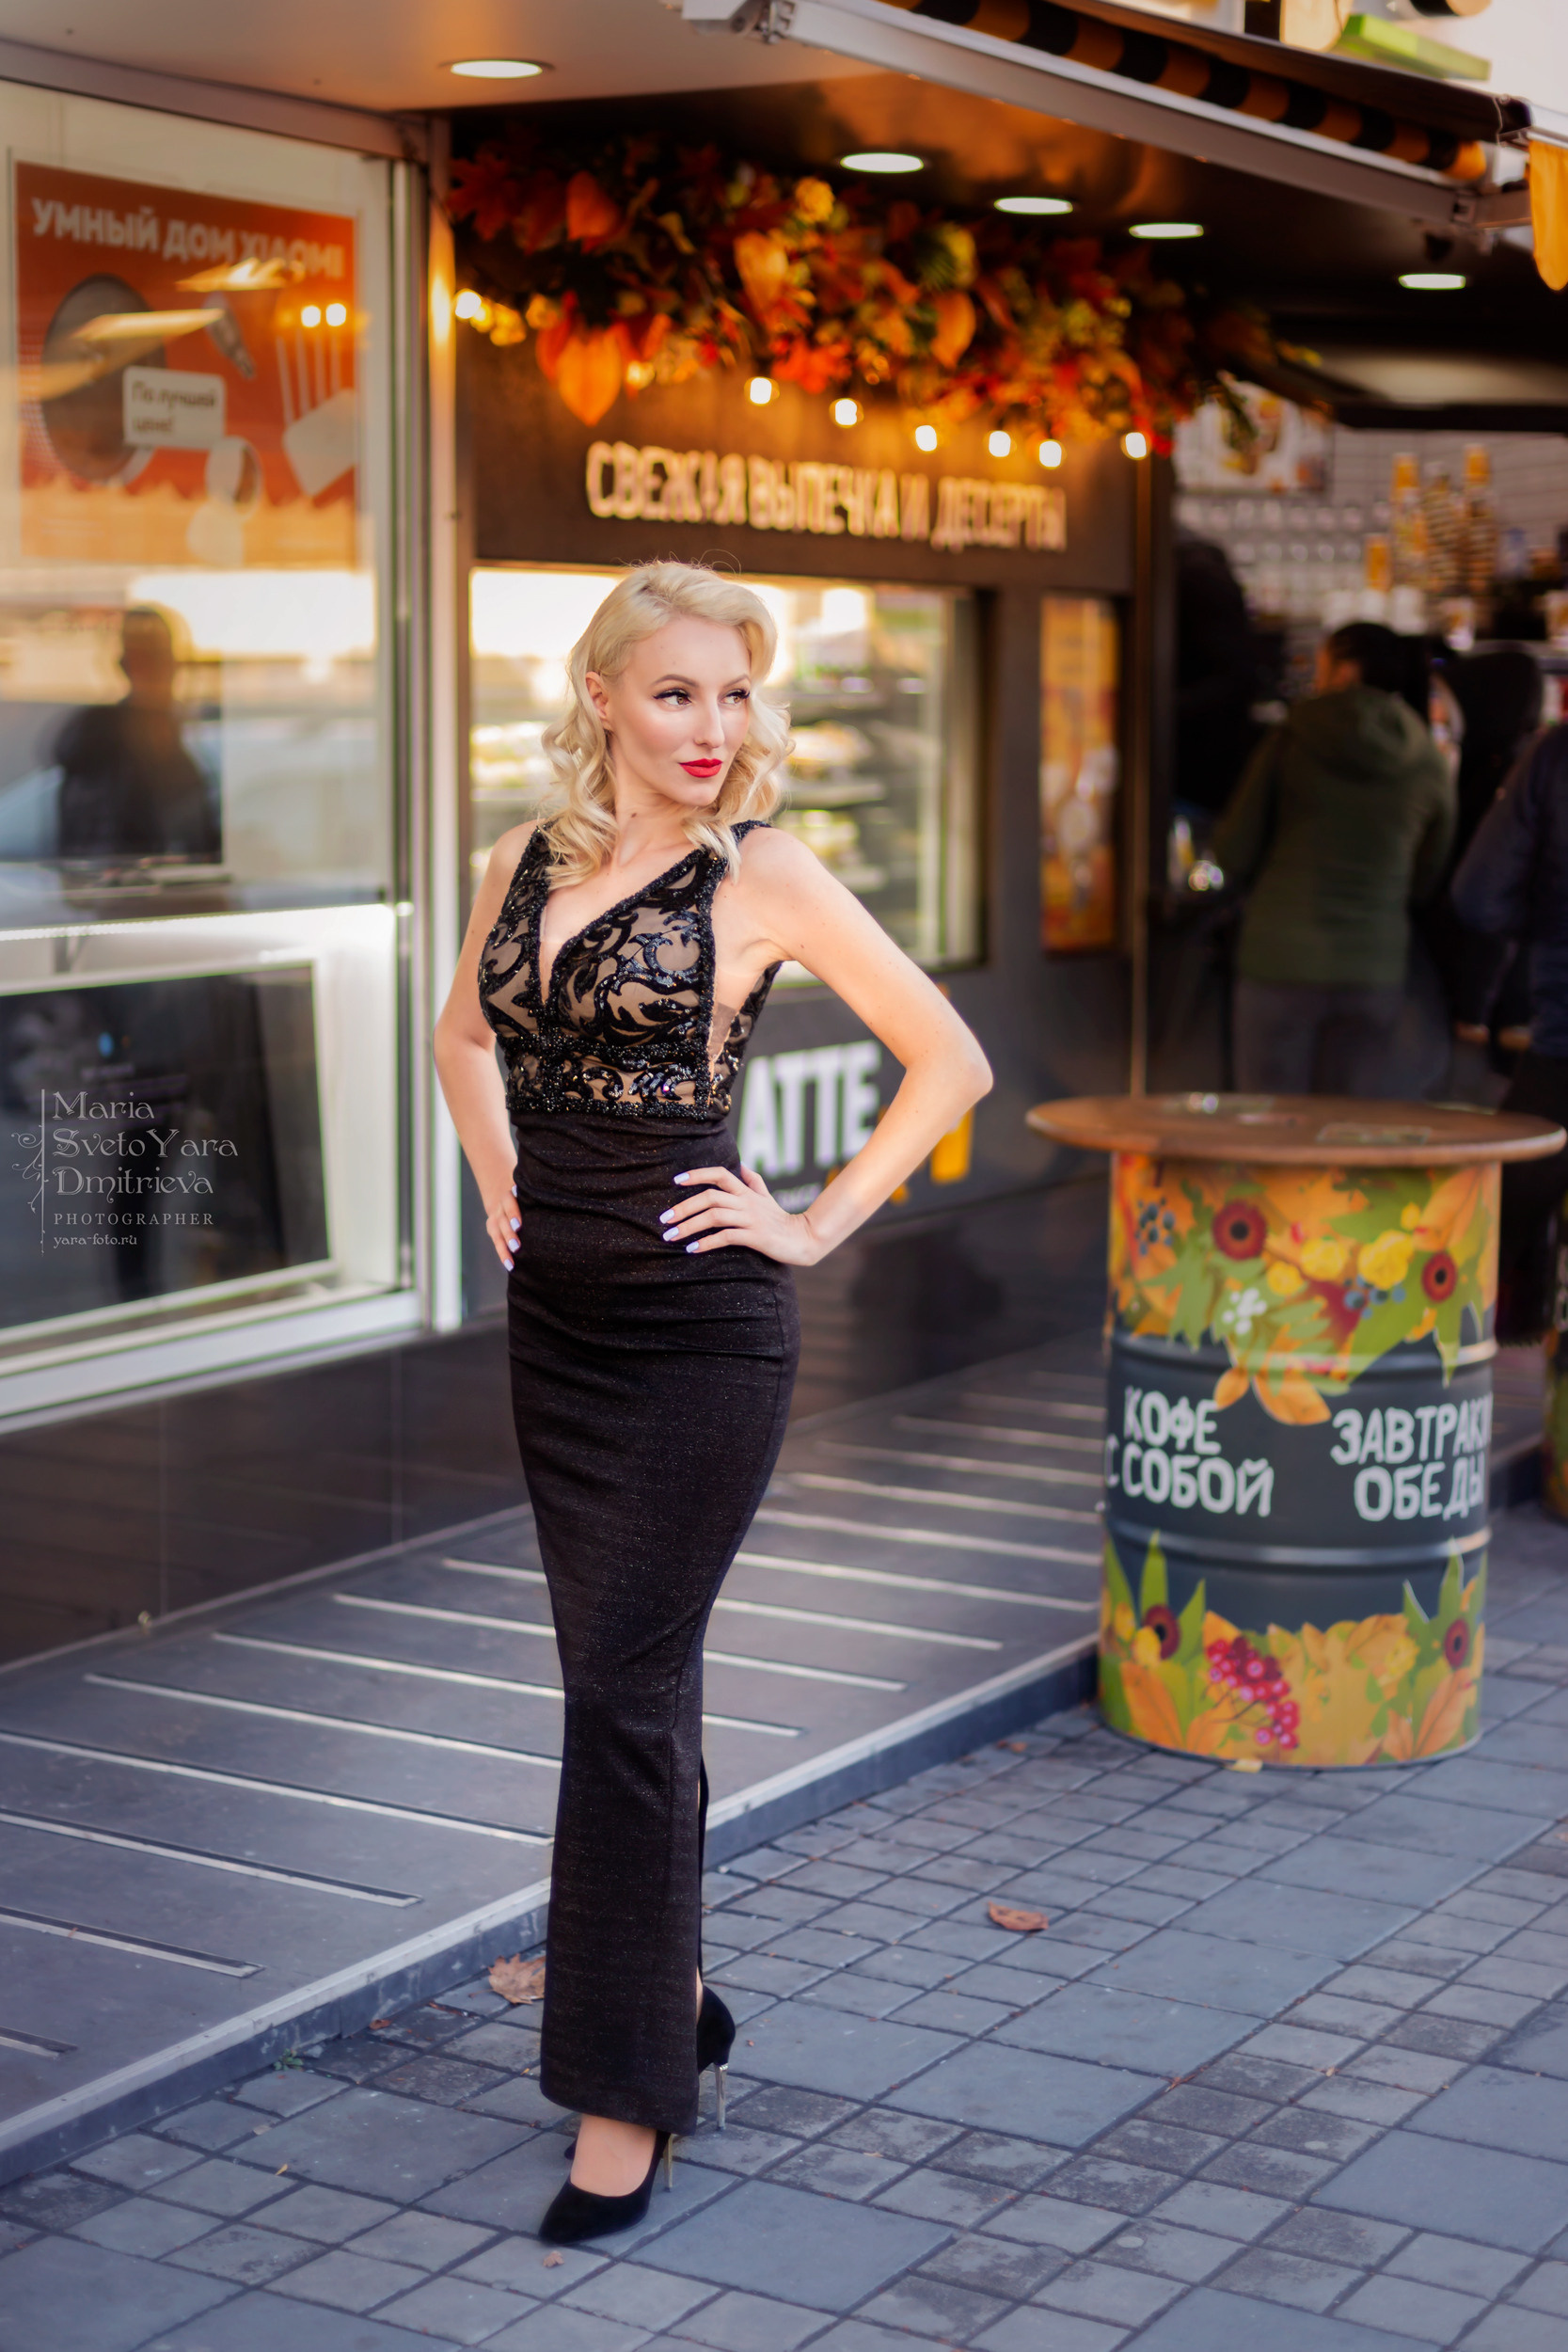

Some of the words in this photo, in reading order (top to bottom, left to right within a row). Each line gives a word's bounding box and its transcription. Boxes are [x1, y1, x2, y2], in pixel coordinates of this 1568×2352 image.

[32, 197, 158, 252] УМНЫЙ
[163, 219, 232, 263] ДОМ
[749, 453, 900, 539] ВЫПЕЧКА
[930, 475, 1068, 554] ДЕСЕРТЫ
[1123, 1386, 1222, 1456] КОФЕ
[1122, 1441, 1275, 1518] СОБОЙ
[1354, 1450, 1485, 1521] ОБЕДЫ
